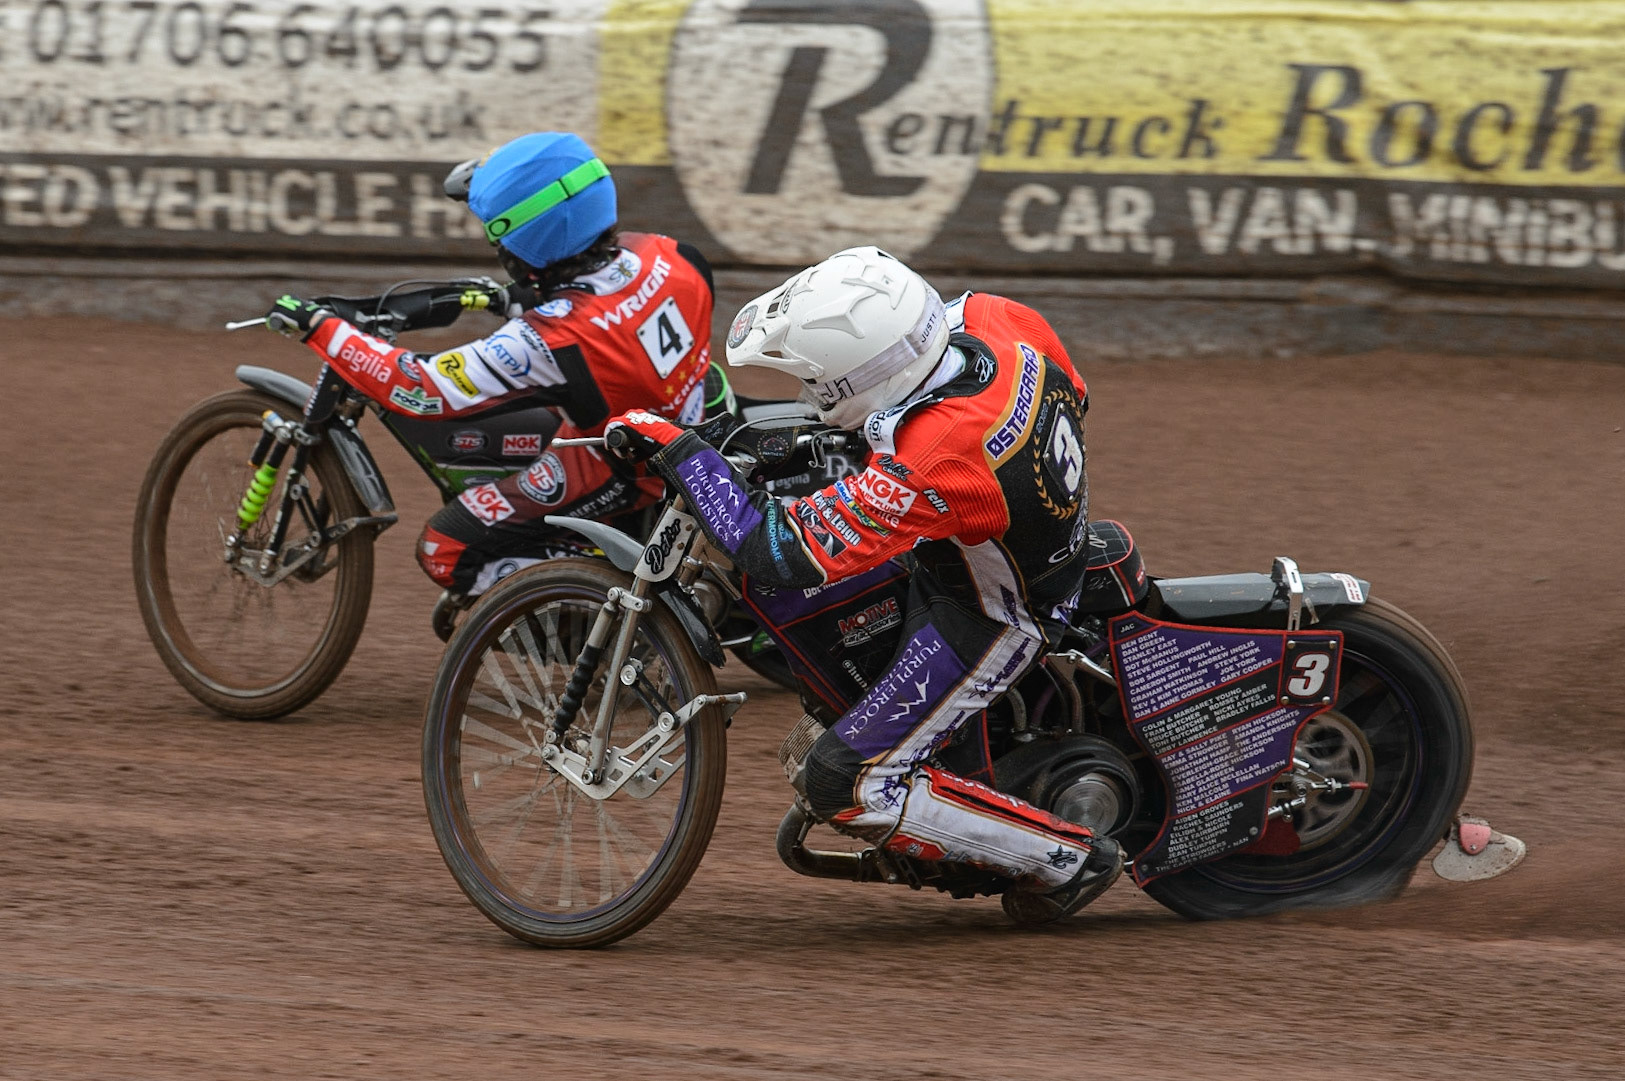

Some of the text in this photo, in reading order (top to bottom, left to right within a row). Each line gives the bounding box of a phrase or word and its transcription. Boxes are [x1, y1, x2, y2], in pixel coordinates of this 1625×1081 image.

[30, 0, 550, 73] 01706 640055
[736, 0, 1625, 197] Rentruck Roch
[107, 166, 400, 236] VEHICLE
[589, 255, 671, 331] WRIGHT
[658, 311, 683, 357] 4
[341, 344, 392, 384] agilia
[504, 436, 539, 449] NGK
[1053, 415, 1083, 493] 3
[529, 462, 555, 491] STS
[860, 470, 910, 510] NGK
[474, 485, 509, 520] NGK
[685, 474, 729, 541] LOGISTICS
[690, 458, 744, 541] PURPLEROCK
[923, 488, 949, 514] Felix
[767, 500, 782, 561] THERMOHOME
[831, 513, 861, 546] Leigh
[838, 597, 899, 635] MOTIVE
[1120, 623, 1135, 633] JAC
[1121, 631, 1158, 650] BEN DENT
[1122, 636, 1165, 657] DAN GREEN
[1122, 639, 1177, 665] STANLEY EAST
[1187, 645, 1226, 663] PAUL HILL
[1197, 640, 1255, 668] ANDREW INGLIS
[1125, 661, 1140, 672] DOT
[1127, 640, 1212, 679] STEVE HOLLINGWORTH
[1214, 647, 1260, 669] STEVE YORK
[1220, 657, 1256, 675] JOE YORK
[1220, 658, 1273, 683] GARY COOPER
[1129, 662, 1180, 687] BOB SARGENT
[1130, 666, 1191, 695] CAMERON SMITH
[1131, 668, 1208, 703] GRAHAM WATKINSON
[1287, 653, 1330, 697] 3
[844, 639, 941, 740] PURPLEROCK
[1132, 701, 1148, 711] KEV
[1157, 691, 1172, 702] KIM
[1172, 678, 1204, 694] THOMAS
[1135, 708, 1151, 718] DAN
[1160, 695, 1180, 708] ANNE
[1180, 680, 1217, 699] GORMLEY
[1209, 683, 1268, 711] ROMSEY AMBER
[1142, 720, 1165, 732] COLIN
[1173, 698, 1214, 719] MARGARET
[1215, 687, 1242, 702] YOUNG
[1213, 694, 1260, 716] NICKI AYRES
[1215, 694, 1276, 723] BRADLEY FALLIS
[1144, 711, 1200, 738] FRAN BUTCHER
[1148, 714, 1209, 744] BRUCE BUTCHER
[1232, 708, 1287, 735] RYAN HICKSON
[1234, 710, 1300, 740] AMANDA KNIGHTS
[1236, 719, 1297, 748] THE ANDERSONS
[1151, 724, 1205, 749] TONI BUTCHER
[1154, 725, 1218, 755] LIBBY LAWRENCE
[1240, 736, 1274, 753] HICKSON
[1161, 754, 1176, 763] RAY
[1185, 741, 1208, 754] SALLY
[1164, 740, 1229, 770] EMMA STROWGER
[1170, 756, 1209, 776] JONATHAN
[1230, 747, 1265, 764] HICKSON
[1196, 766, 1235, 786] GLASHEEN
[1254, 760, 1286, 776] WATSON
[1175, 790, 1197, 801] MARY
[1198, 780, 1220, 793] ALICE
[1176, 782, 1230, 808] KEN MALCOLM
[1177, 805, 1198, 814] NICK
[1205, 788, 1232, 804] ELAINE
[1173, 801, 1244, 831] RACHEL SAUNDERS
[1175, 800, 1229, 825] AIDEN GROVES
[1204, 813, 1232, 828] NICOLE
[1168, 828, 1228, 853] DUDLEY TURPIN
[1169, 821, 1230, 845] ALEX FAIRBAIRN
[1168, 838, 1217, 859] JEAN TURPIN
